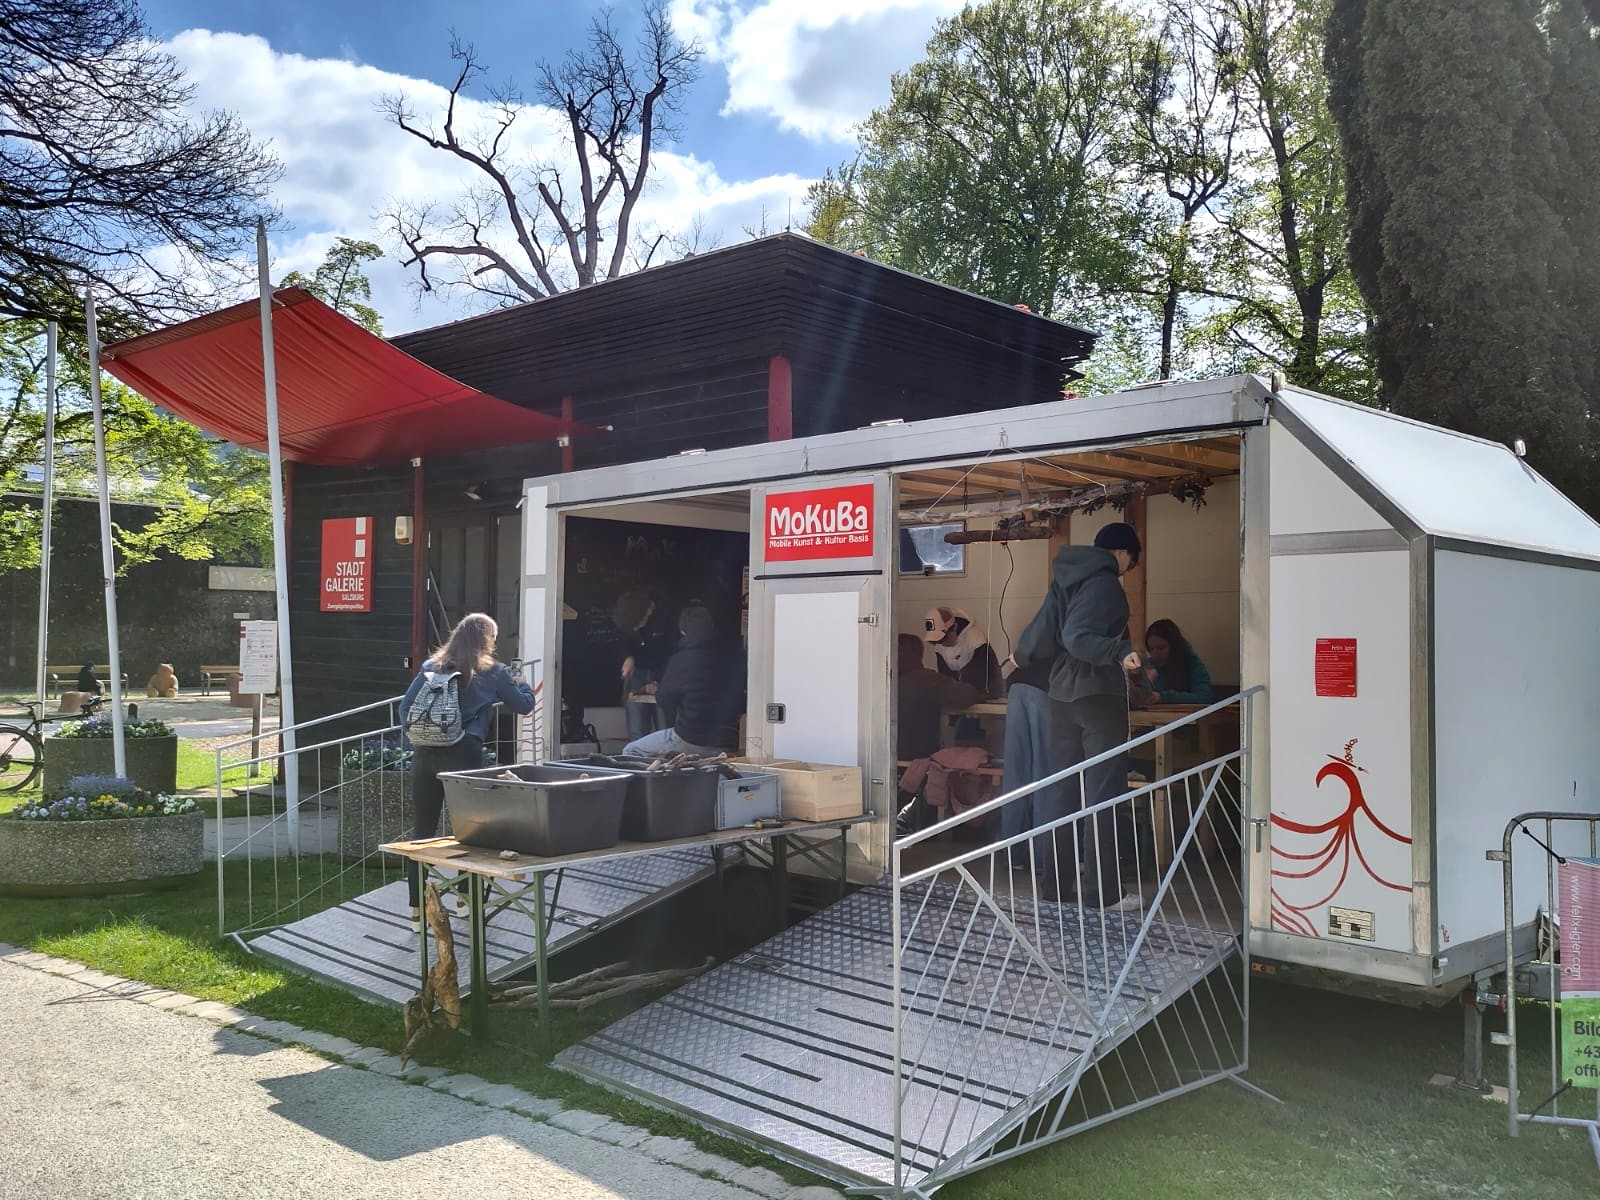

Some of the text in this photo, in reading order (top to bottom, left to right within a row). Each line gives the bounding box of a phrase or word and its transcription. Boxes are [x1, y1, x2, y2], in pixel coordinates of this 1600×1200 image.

[770, 501, 868, 536] MoKuBa
[769, 534, 869, 549] Mobile Kunst & Kultur Basis
[336, 561, 365, 576] STADT
[325, 577, 365, 592] GALERIE
